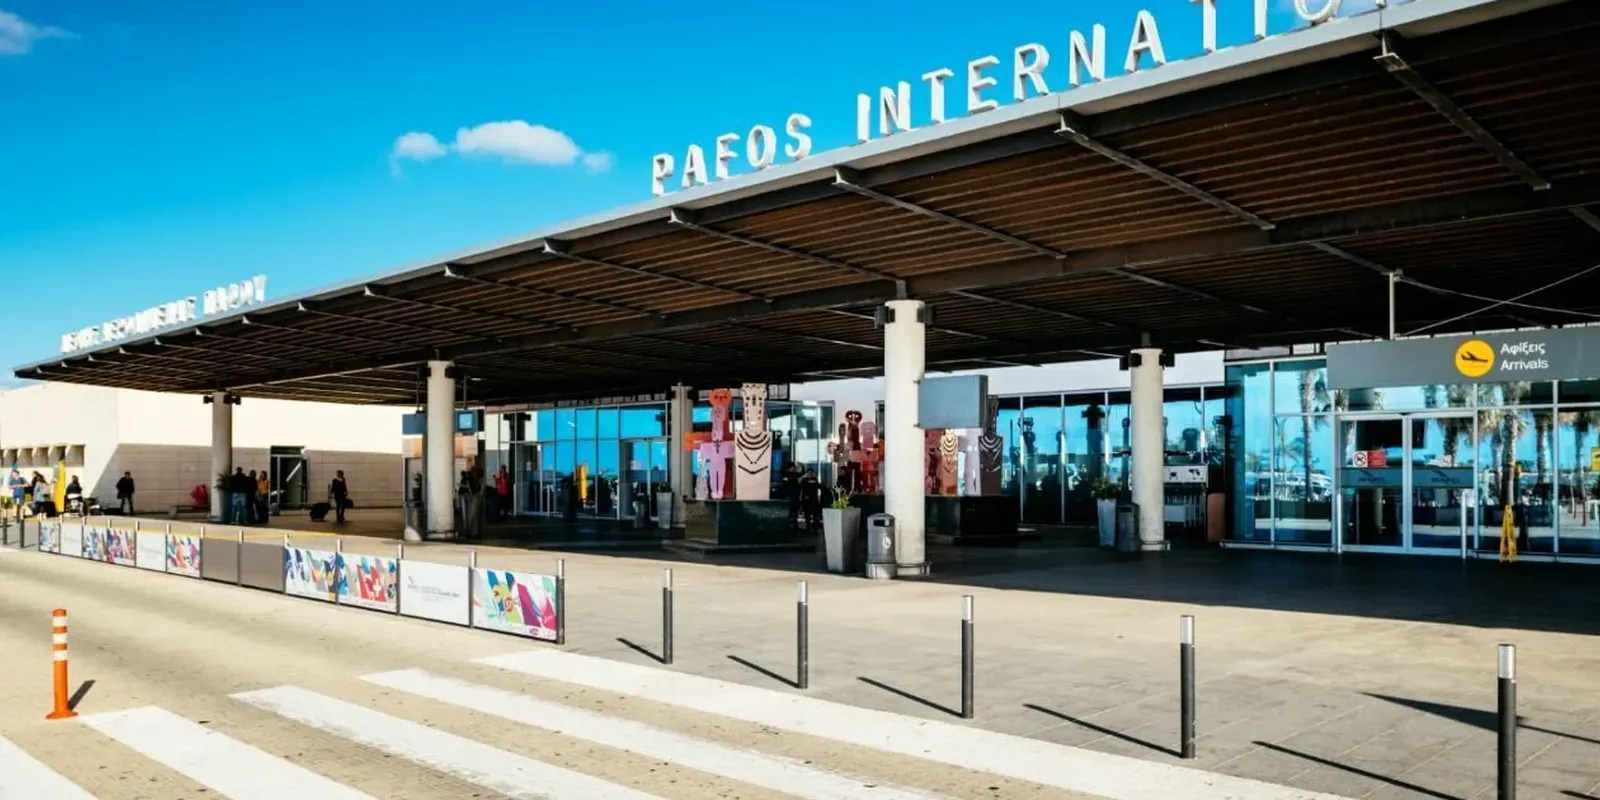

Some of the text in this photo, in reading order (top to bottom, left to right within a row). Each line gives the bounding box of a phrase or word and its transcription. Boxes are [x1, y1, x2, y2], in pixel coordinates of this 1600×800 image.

[652, 0, 1386, 196] PAFOS INTERNATI
[1500, 357, 1549, 371] Arrivals
